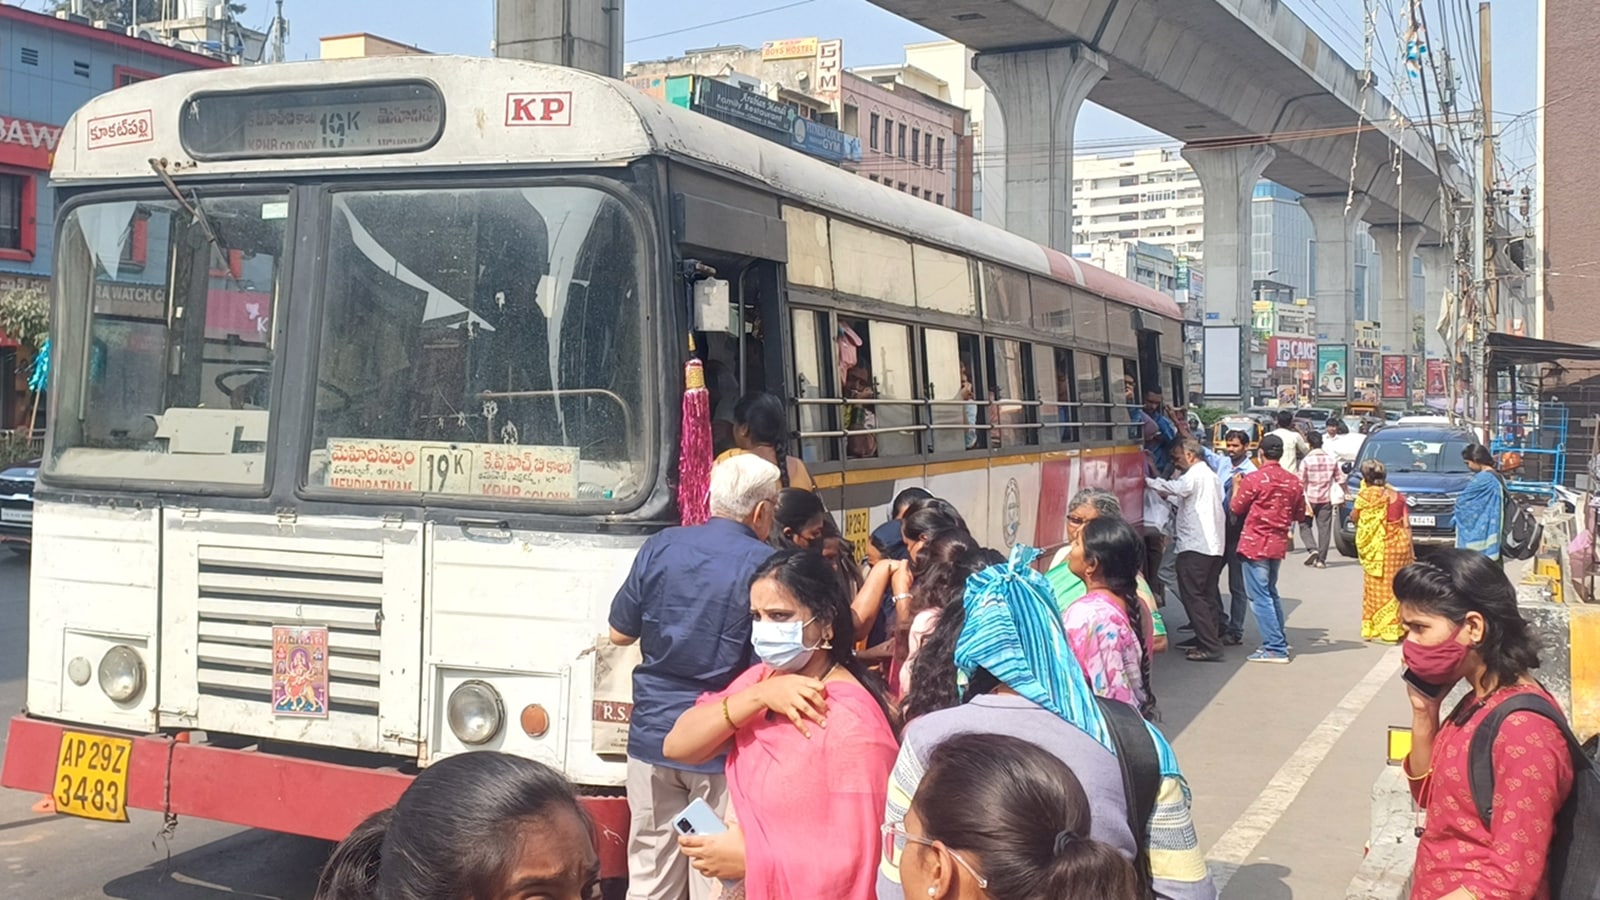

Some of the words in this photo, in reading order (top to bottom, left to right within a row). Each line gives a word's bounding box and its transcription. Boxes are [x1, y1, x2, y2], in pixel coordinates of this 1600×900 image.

[820, 43, 837, 89] GYM
[511, 98, 564, 121] KP
[822, 138, 841, 153] GYM
[112, 287, 151, 301] WATCH
[61, 738, 126, 774] AP29Z
[58, 774, 119, 813] 3483
